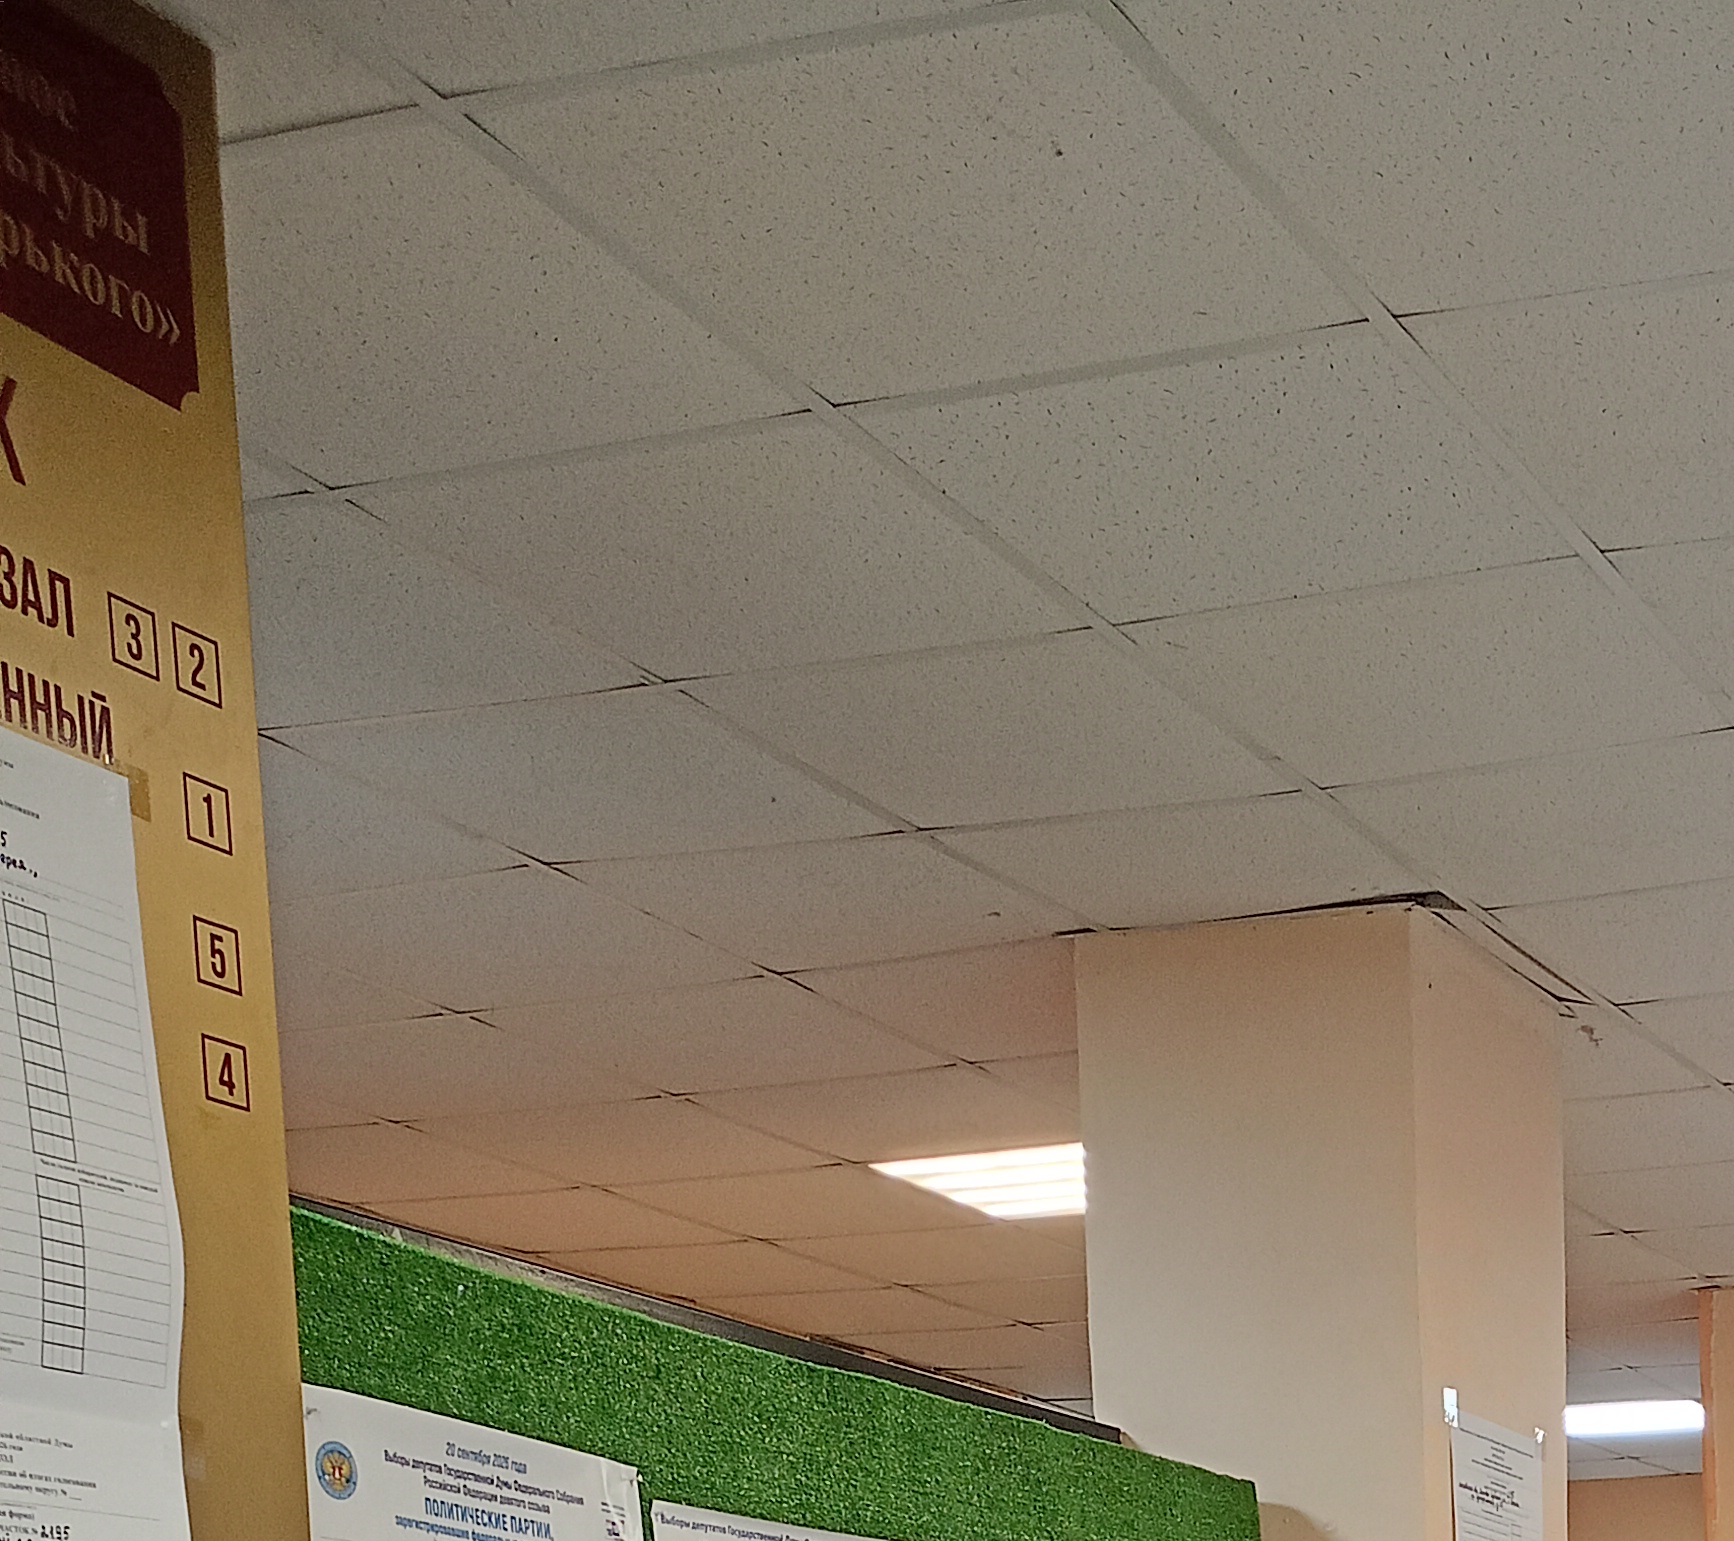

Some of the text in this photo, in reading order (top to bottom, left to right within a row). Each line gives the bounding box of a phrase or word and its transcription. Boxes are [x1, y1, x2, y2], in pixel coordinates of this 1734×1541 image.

[0, 545, 75, 638] ЗАЛ
[126, 612, 207, 692] 3 2
[202, 792, 215, 839] 1
[210, 934, 226, 980] 5
[218, 1051, 236, 1097] 4
[424, 1496, 509, 1532] ПОЛИТИЧЕСКИЕ
[660, 1512, 691, 1530] Выборы
